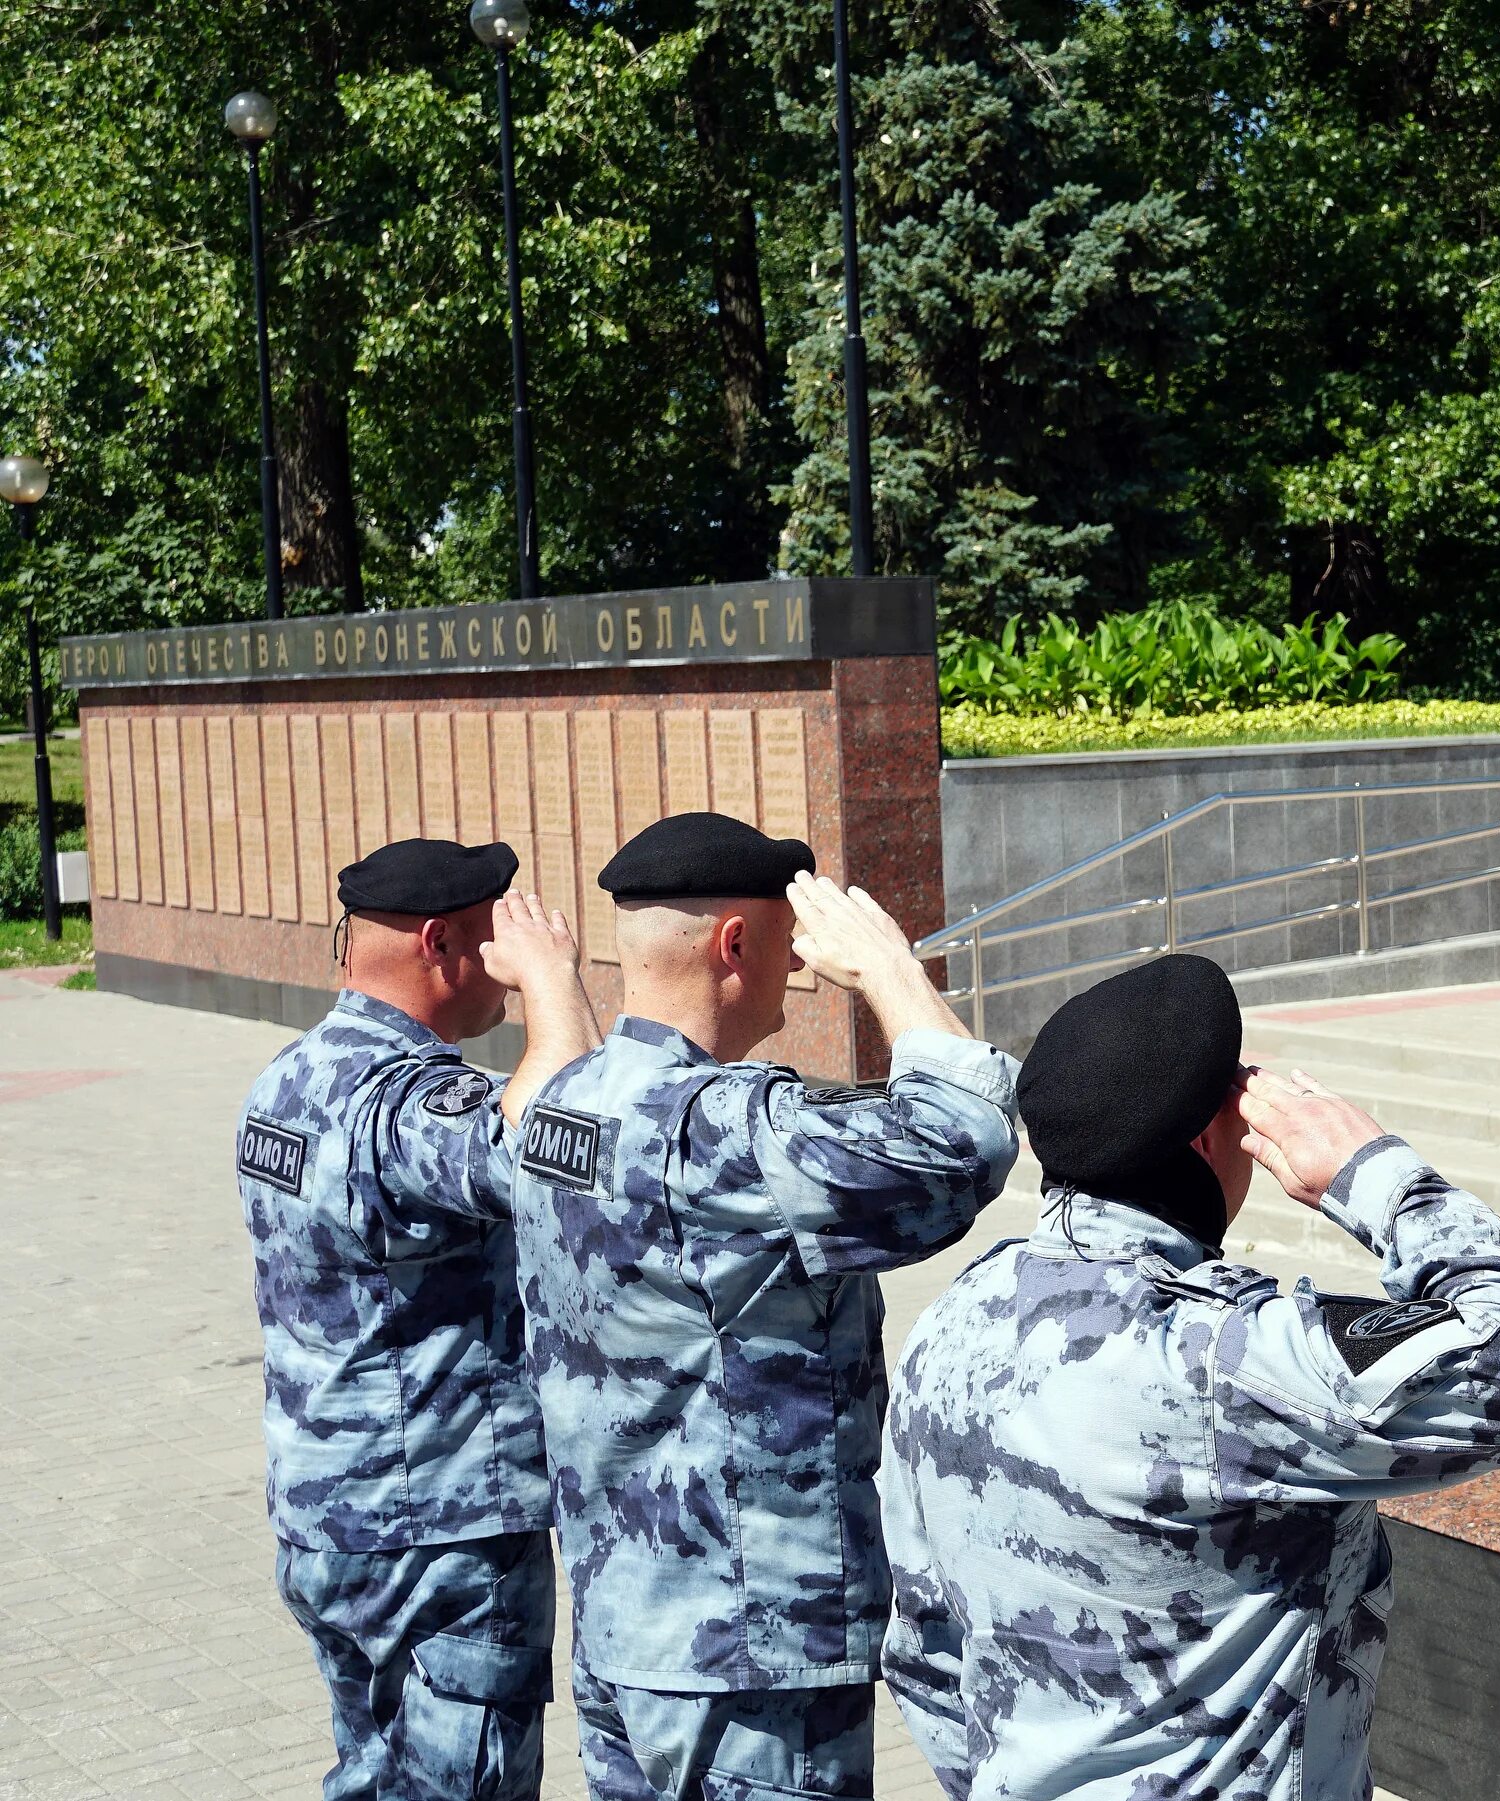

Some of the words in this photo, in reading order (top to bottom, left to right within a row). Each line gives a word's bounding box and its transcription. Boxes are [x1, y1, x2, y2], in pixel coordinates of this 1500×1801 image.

[62, 644, 126, 677] ГЕРОИ
[148, 632, 290, 674] ОТЕЧЕСТВА
[314, 607, 558, 666] ВОРОНЕЖСКОЙ
[597, 597, 805, 652] ОБЛАСТИ
[244, 1131, 298, 1178] ОМОН
[528, 1120, 591, 1171] ОМОН
